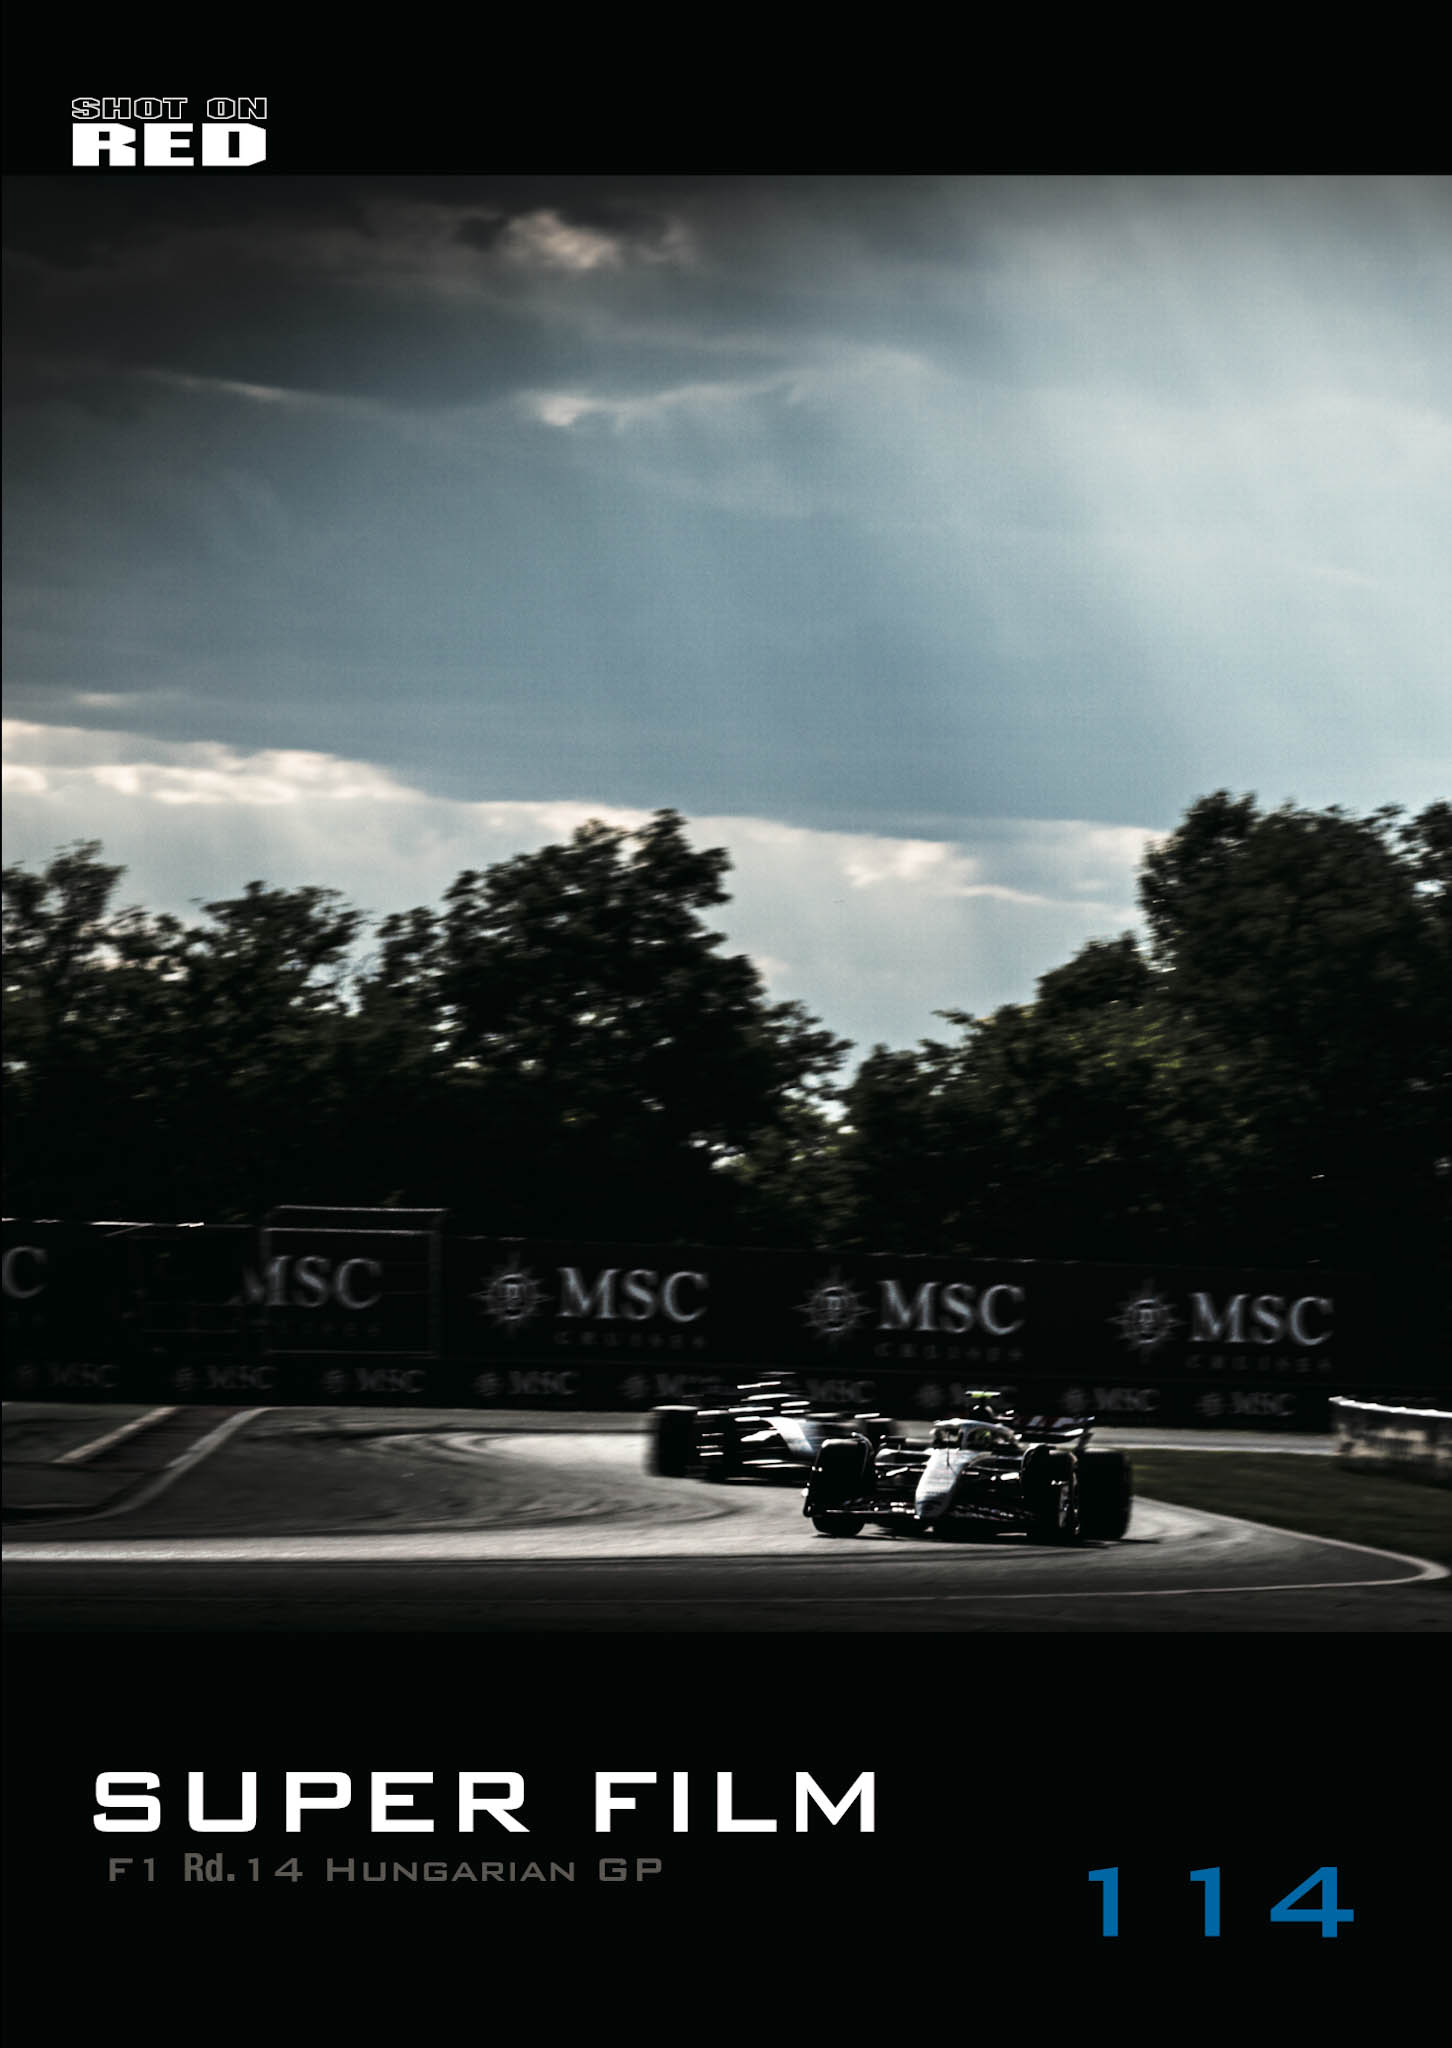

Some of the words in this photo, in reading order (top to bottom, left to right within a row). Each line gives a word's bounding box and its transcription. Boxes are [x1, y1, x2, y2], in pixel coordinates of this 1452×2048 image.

[556, 1266, 709, 1322] MSC
[876, 1280, 1026, 1336] MSC
[1188, 1291, 1334, 1347] MSC
